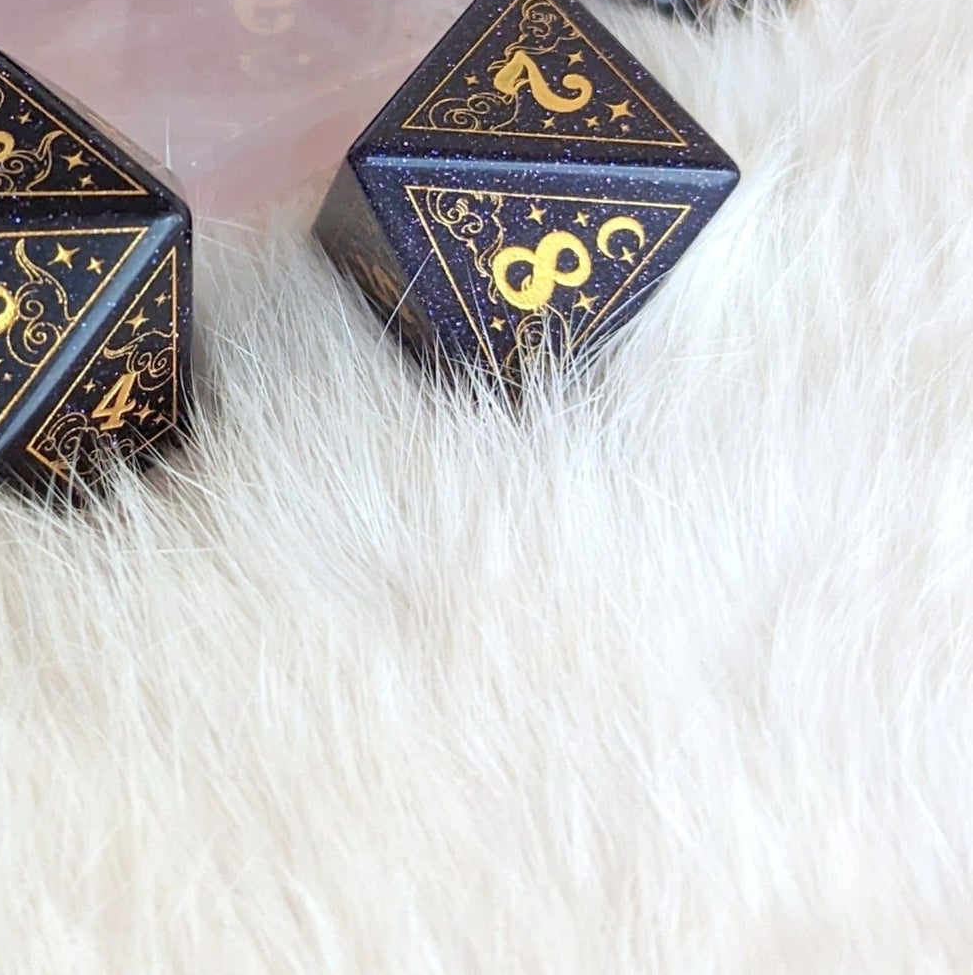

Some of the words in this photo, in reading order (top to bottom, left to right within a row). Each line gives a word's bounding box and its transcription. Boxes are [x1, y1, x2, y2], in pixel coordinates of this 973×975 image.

[493, 50, 593, 113] 2
[492, 230, 593, 311] 8
[91, 372, 139, 431] 4
